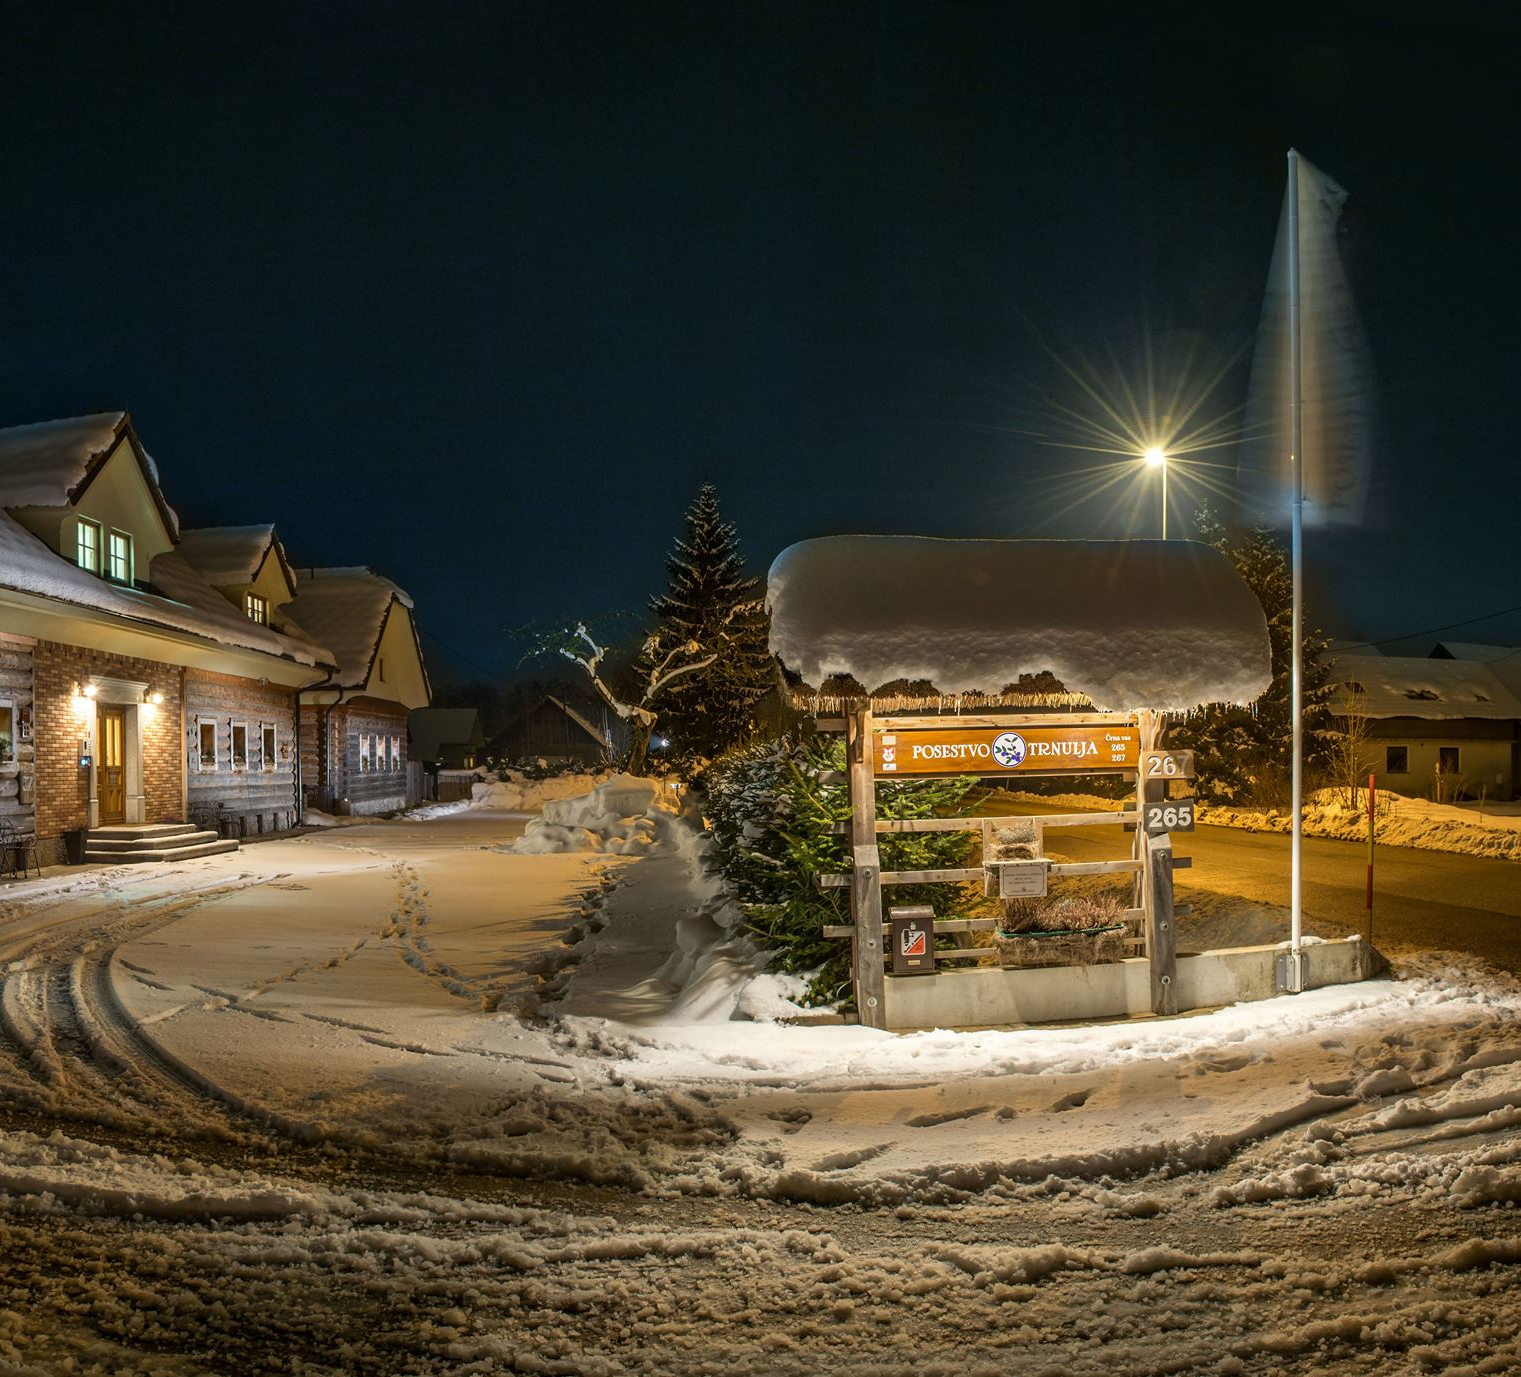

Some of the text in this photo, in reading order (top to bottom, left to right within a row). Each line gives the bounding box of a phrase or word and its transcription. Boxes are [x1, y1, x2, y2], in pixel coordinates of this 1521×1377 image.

[1105, 733, 1120, 741] Črna
[912, 741, 1099, 759] POSESTVO TRNULJA
[1111, 754, 1125, 762] 267
[1148, 755, 1189, 775] 267
[1148, 807, 1191, 828] 265
